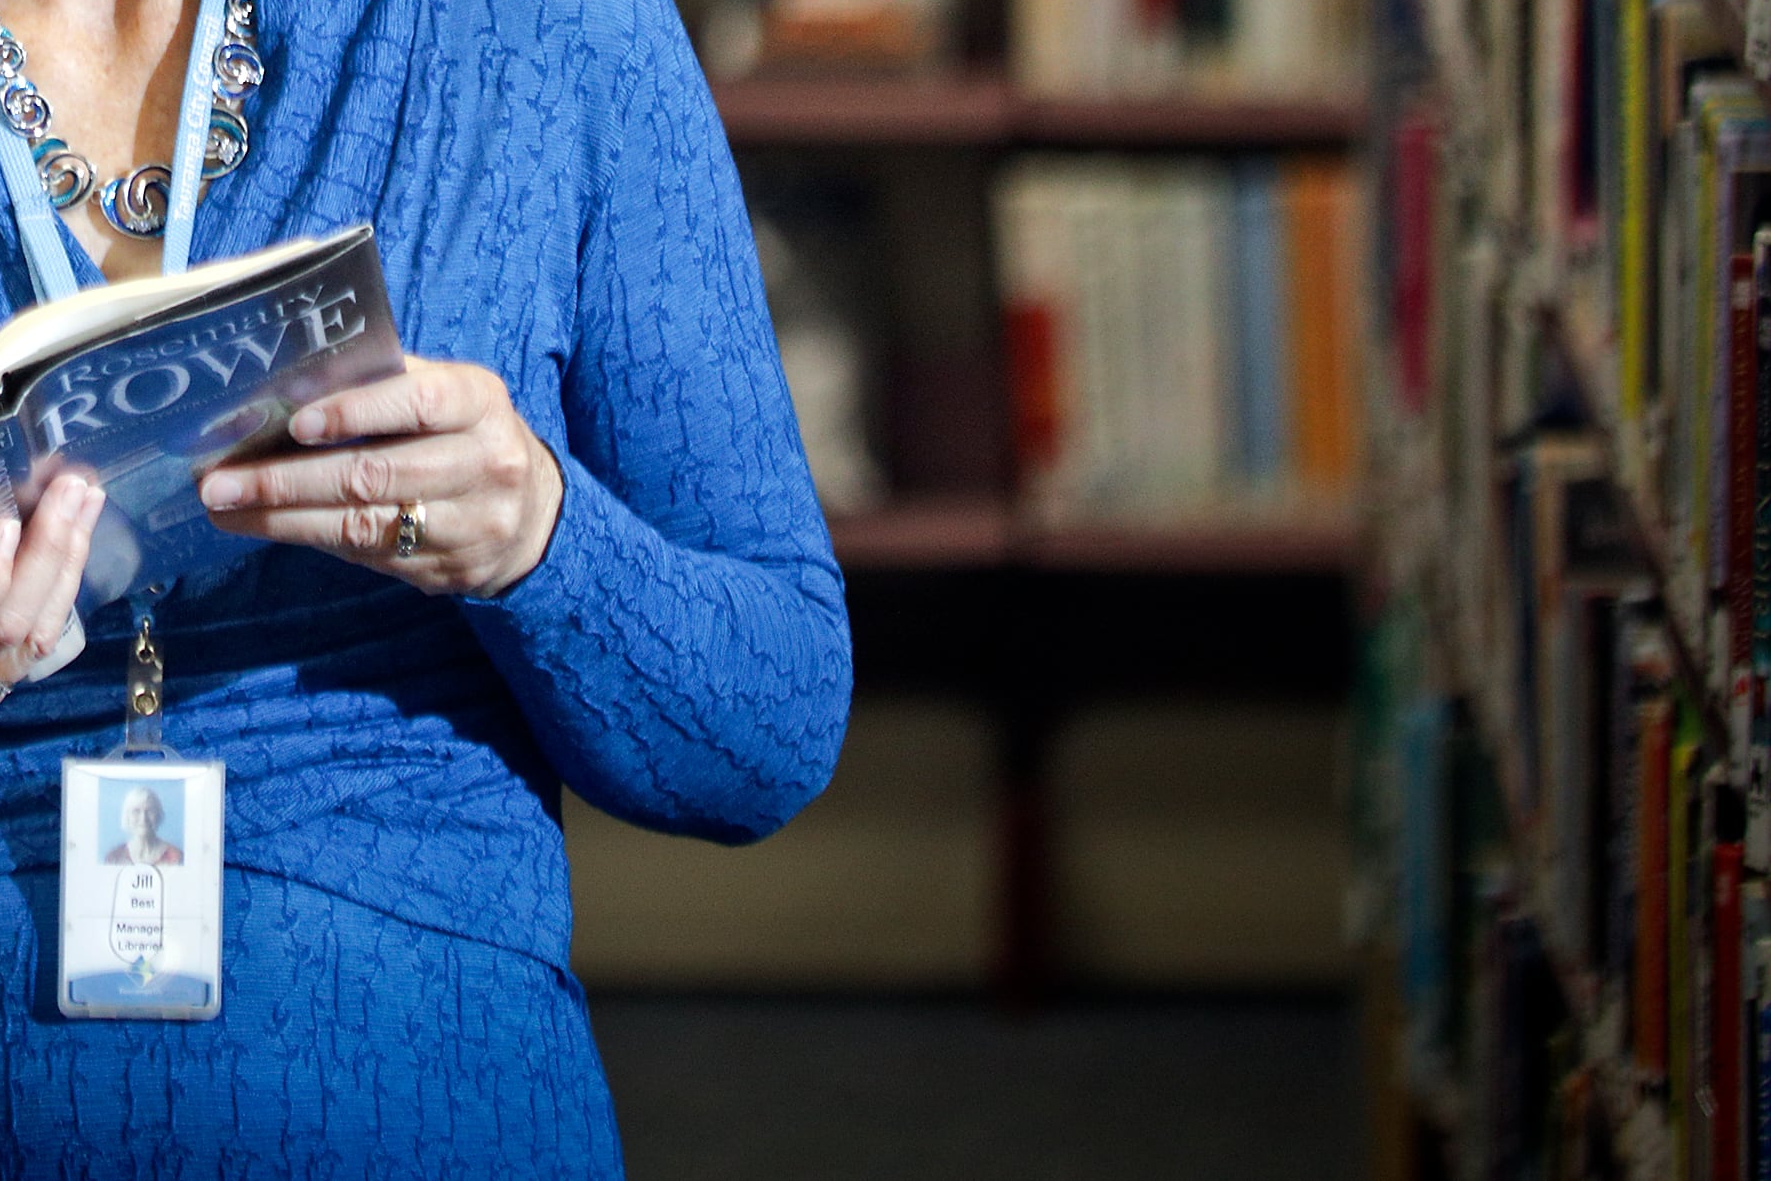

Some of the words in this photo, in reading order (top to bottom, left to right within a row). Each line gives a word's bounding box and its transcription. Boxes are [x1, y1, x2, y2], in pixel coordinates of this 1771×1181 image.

[196, 17, 220, 80] Council
[188, 82, 208, 128] City
[176, 132, 203, 220] Tauranga
[59, 285, 323, 393] Rosemary
[36, 290, 365, 456] ROWE
[131, 898, 155, 909] Best
[132, 874, 153, 889] Jill
[117, 923, 163, 936] Manager
